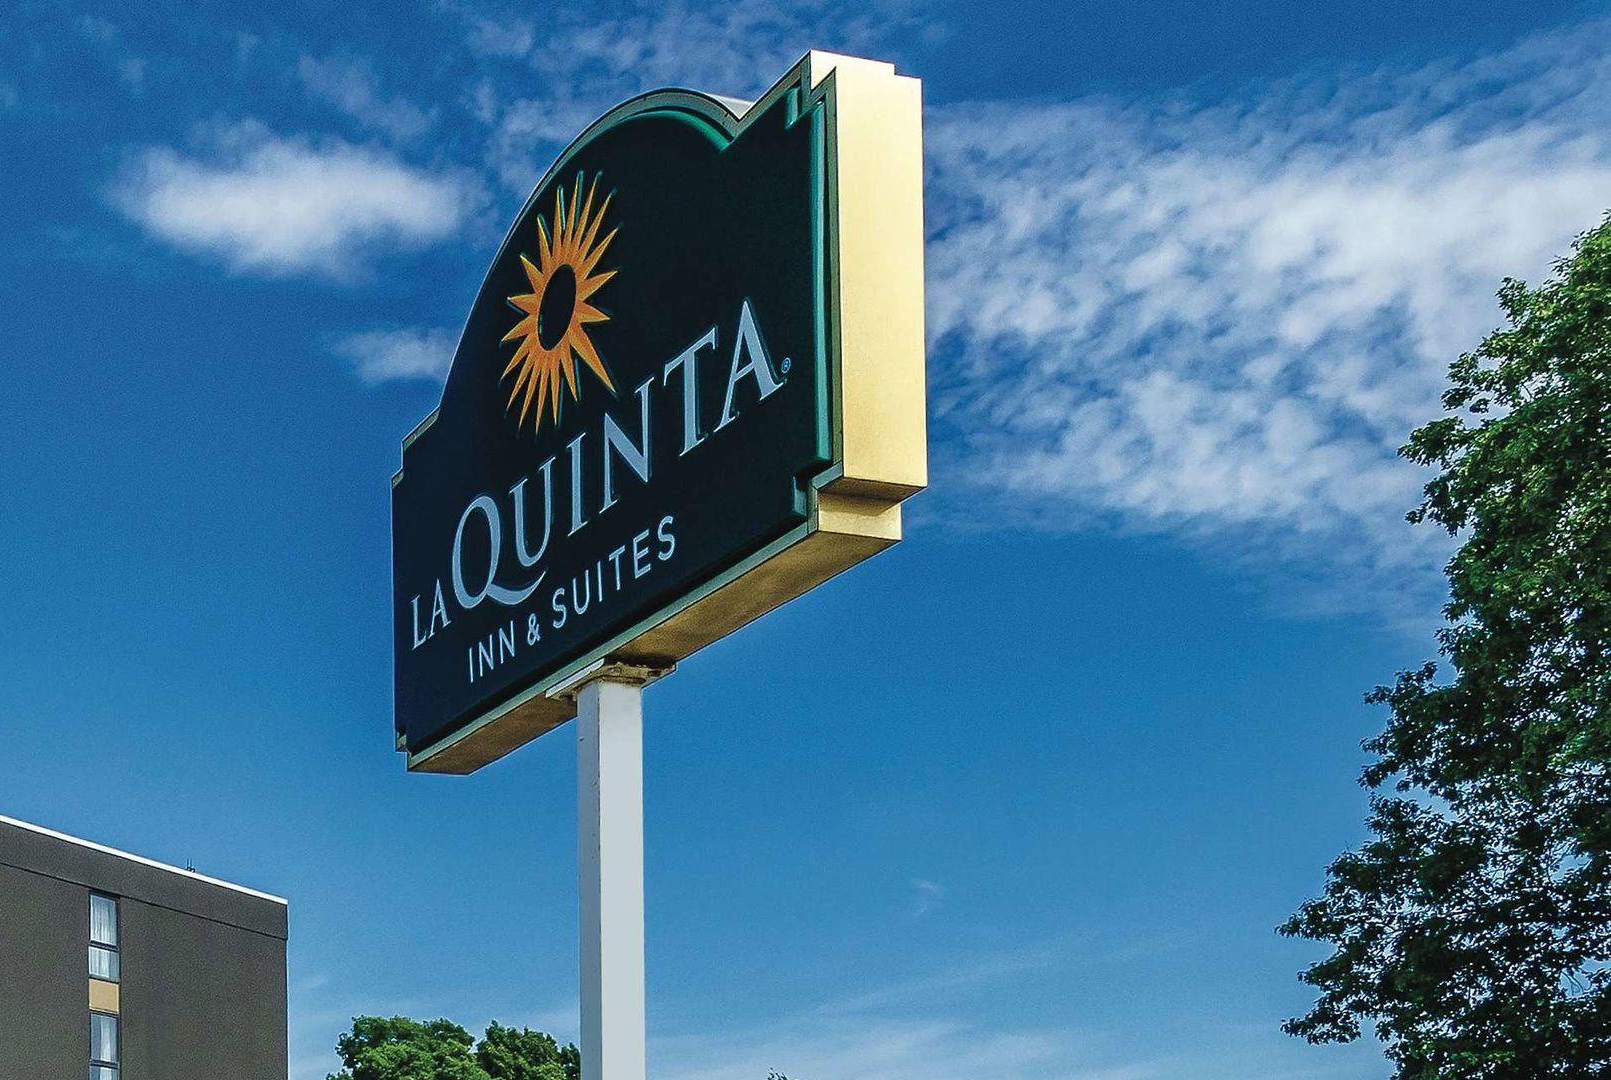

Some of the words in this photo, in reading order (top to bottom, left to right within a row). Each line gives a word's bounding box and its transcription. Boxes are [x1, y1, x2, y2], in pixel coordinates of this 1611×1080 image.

[411, 578, 452, 650] LA
[452, 298, 784, 609] QUINTA
[467, 620, 516, 684] INN
[526, 612, 541, 647] &
[551, 515, 676, 630] SUITES
